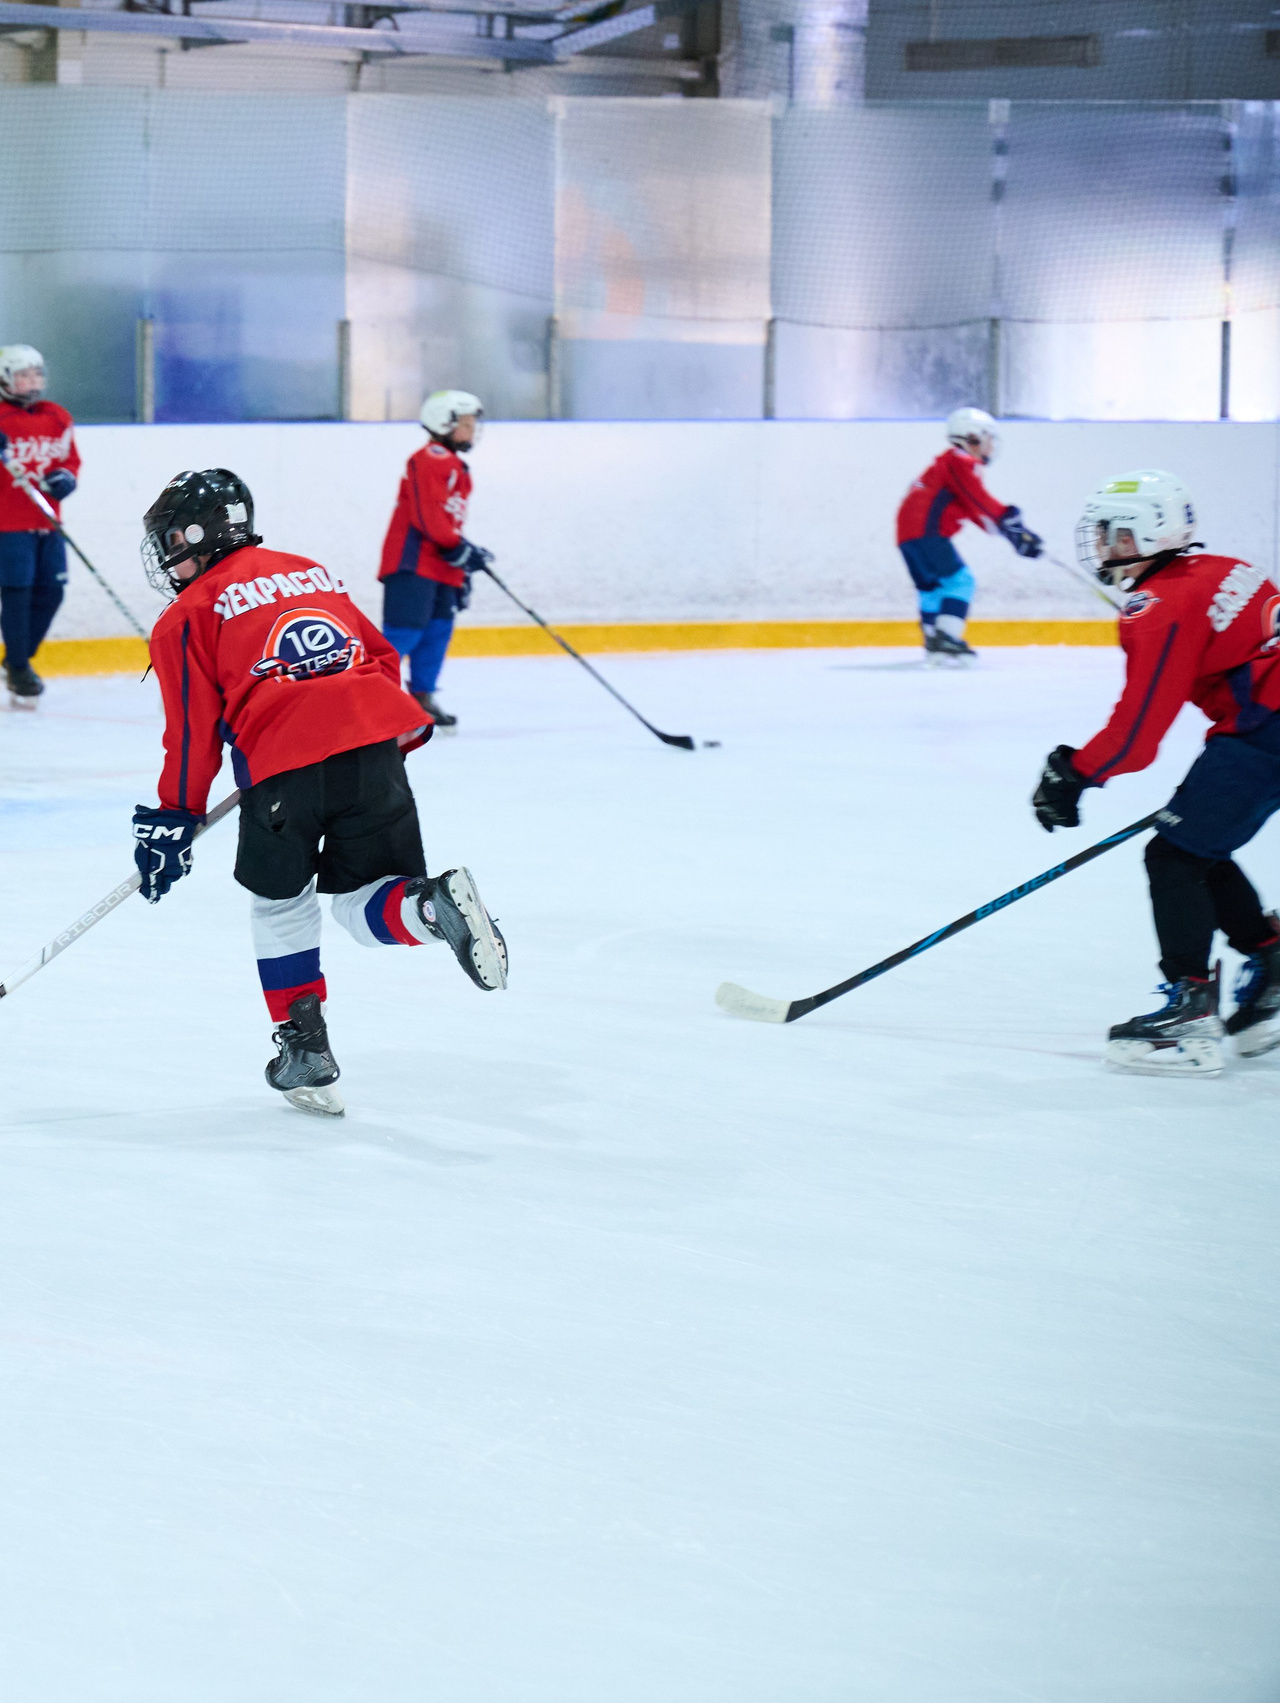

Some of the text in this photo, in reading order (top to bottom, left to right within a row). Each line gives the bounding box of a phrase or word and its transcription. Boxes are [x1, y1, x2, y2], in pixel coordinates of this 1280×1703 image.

[285, 624, 335, 658] 10
[132, 823, 186, 841] CM
[55, 882, 133, 947] RIBCOR
